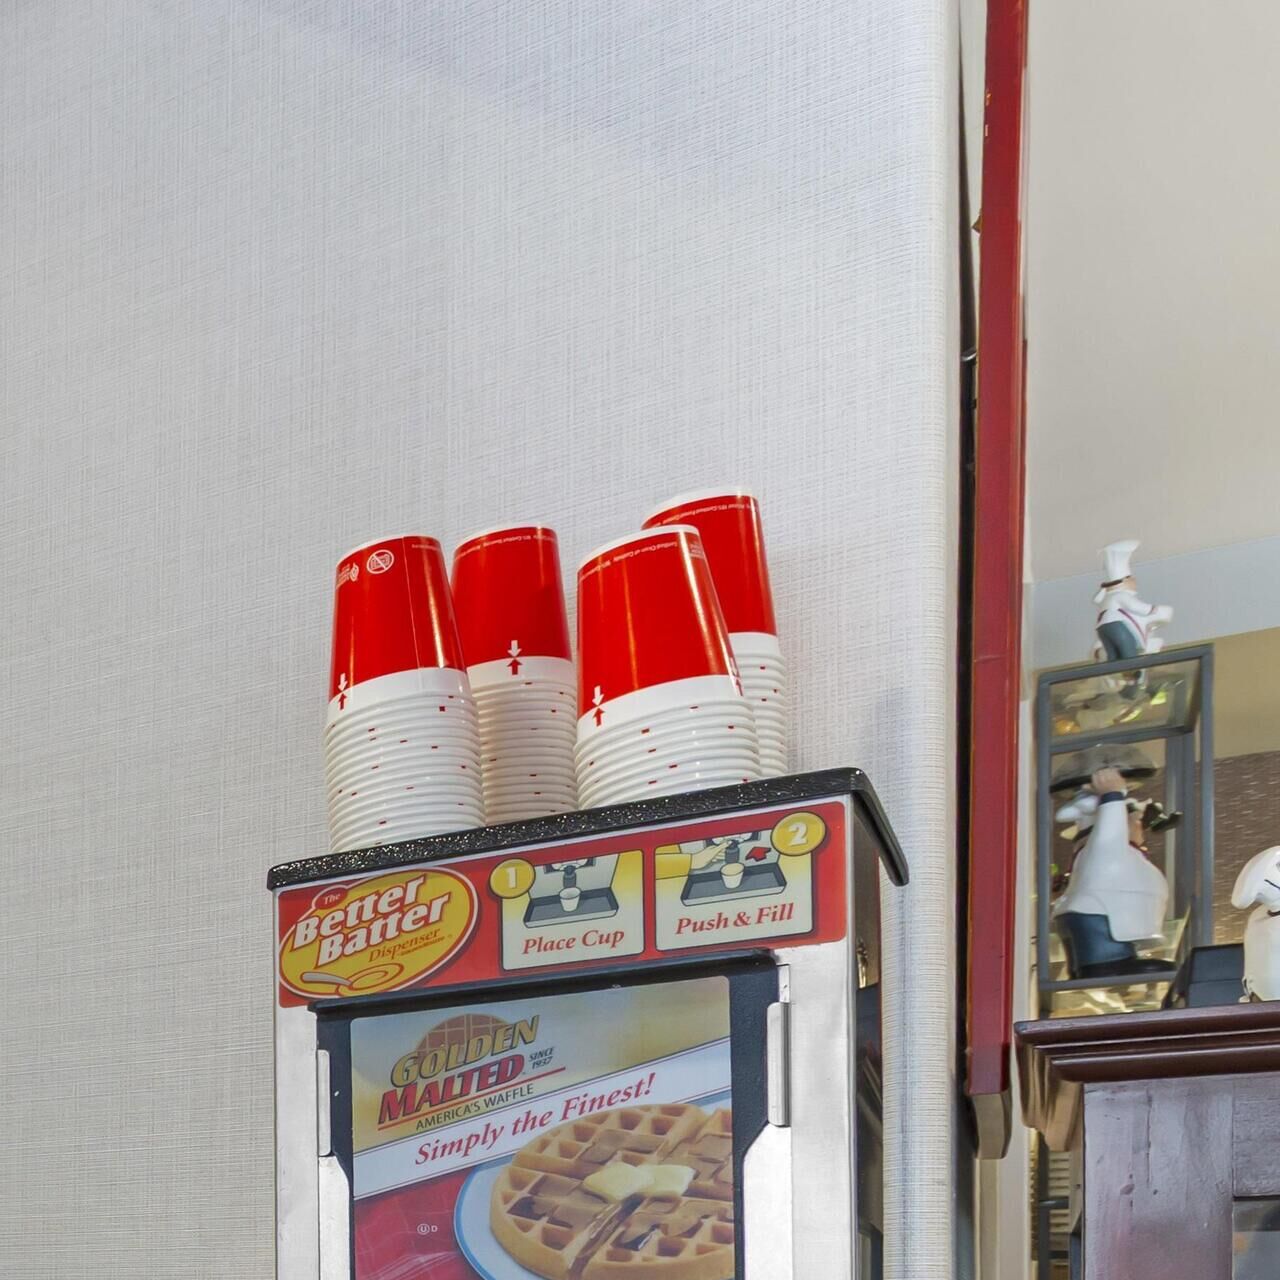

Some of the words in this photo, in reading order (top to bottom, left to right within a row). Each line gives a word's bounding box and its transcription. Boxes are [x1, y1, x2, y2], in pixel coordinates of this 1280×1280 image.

[788, 822, 808, 846] 2
[506, 867, 517, 889] 1
[292, 874, 426, 950] Better
[323, 892, 341, 905] The
[315, 892, 451, 969] Batter
[675, 911, 730, 935] Push
[733, 912, 751, 927] &
[754, 902, 794, 925] Fill
[368, 928, 441, 962] Dispenser
[522, 934, 575, 955] Place
[581, 929, 625, 950] Cup
[391, 1014, 540, 1088] GOLDEN
[528, 1046, 555, 1063] SINCE
[377, 1054, 525, 1125] MALTED
[415, 1122, 505, 1165] Simply
[511, 1109, 553, 1136] the
[559, 1072, 657, 1123] Finest!
[416, 1101, 481, 1131] AMERICA'S
[483, 1083, 534, 1109] WAFFLE
